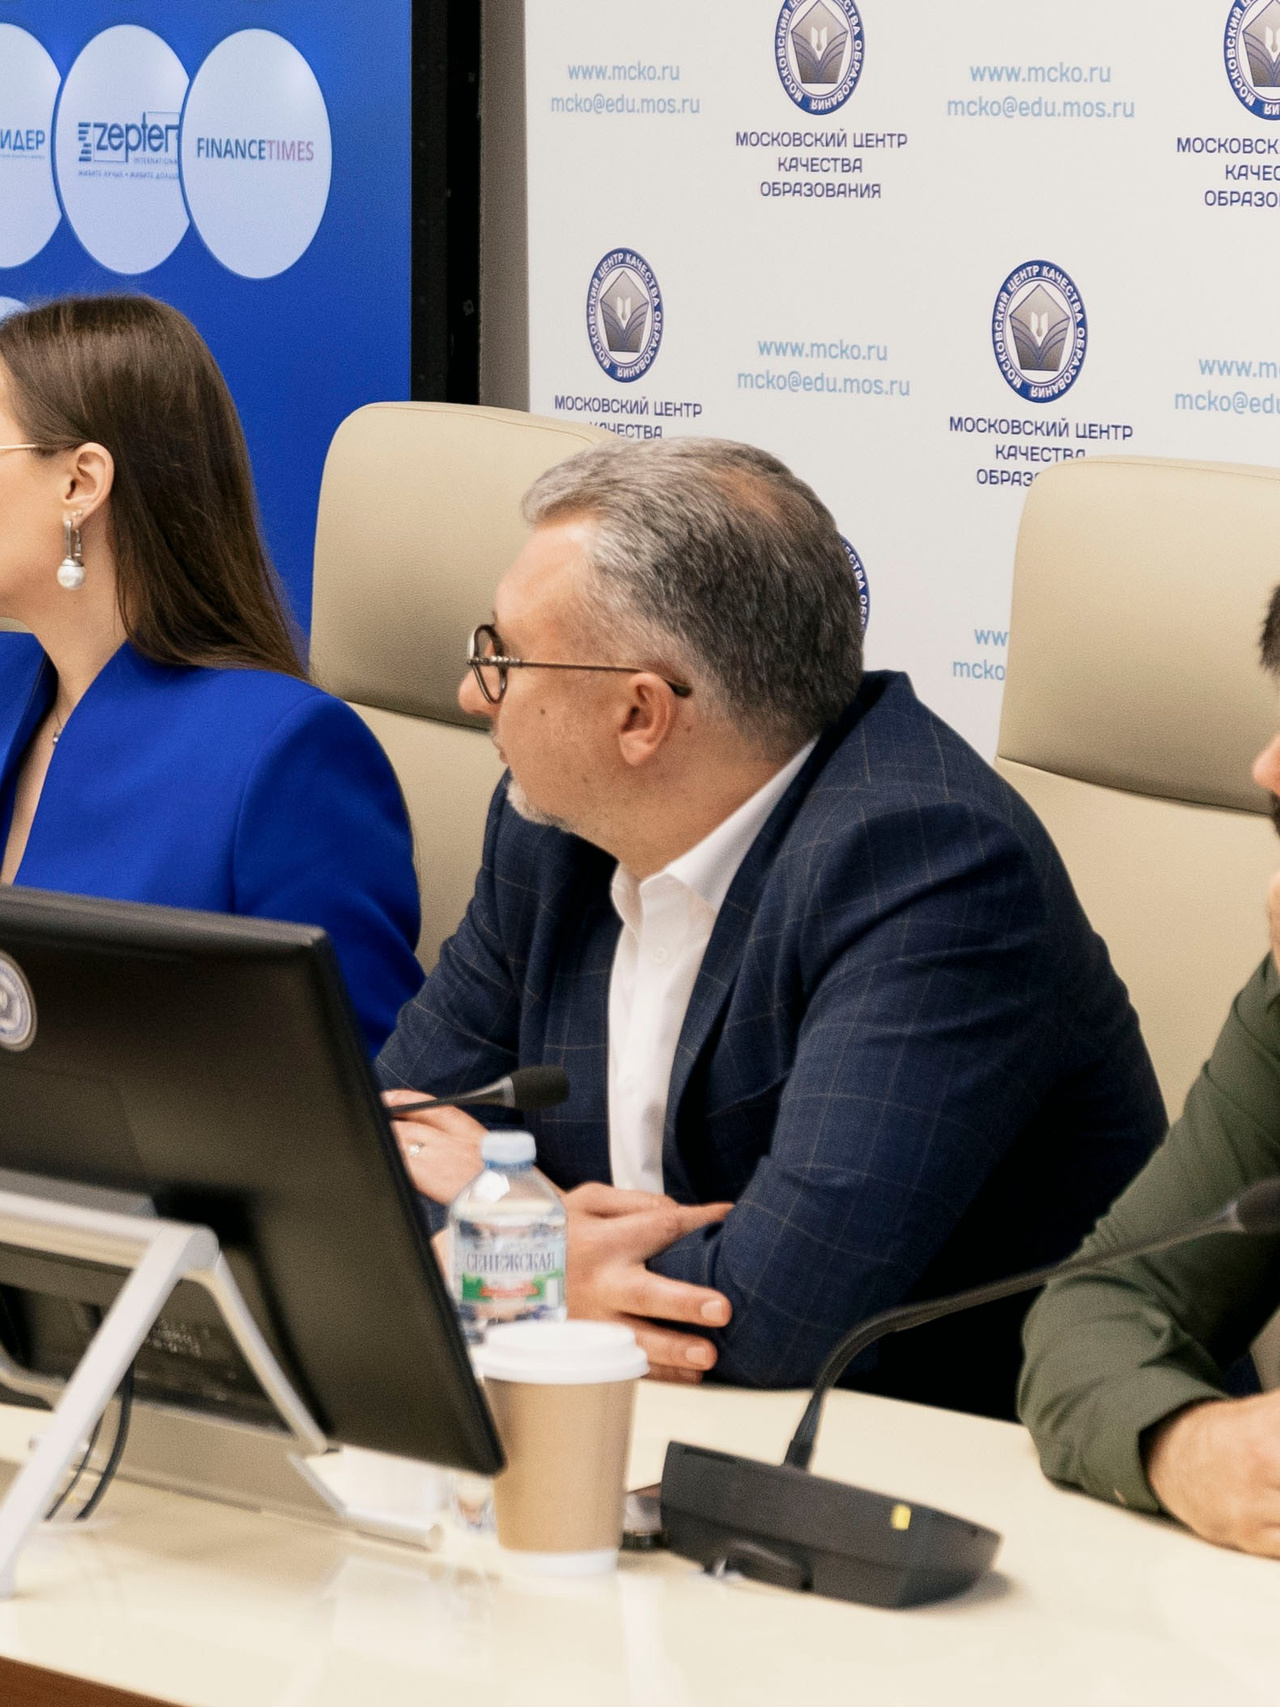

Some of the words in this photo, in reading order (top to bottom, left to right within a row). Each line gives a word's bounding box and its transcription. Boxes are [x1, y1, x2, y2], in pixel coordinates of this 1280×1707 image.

[567, 61, 680, 82] www.mcko.ru
[970, 62, 1112, 84] www.mcko.ru
[550, 94, 700, 115] mcko@edu.mos.ru
[947, 96, 1135, 119] mcko@edu.mos.ru
[735, 128, 847, 149] МОСКОВСКИЙ
[853, 132, 908, 149] ЦЕНТР
[1176, 137, 1280, 154] МОСКОВСК
[778, 157, 863, 174] КАЧЕСТВА
[1225, 164, 1280, 181] КАЧЕС
[760, 182, 882, 199] ОБРАЗОВАНИЯ
[1204, 189, 1280, 208] ОБРАЗО
[1007, 265, 1040, 291] ЦЕНТР
[1042, 266, 1084, 323] КАЧЕСТВА
[757, 339, 888, 361] www.mcko.ru
[1031, 327, 1086, 398] ОБРАЗОВАНИЯ
[1199, 358, 1280, 379] www.m
[737, 369, 910, 397] mcko@edu.mos.ru
[554, 395, 649, 415] МОСКОВСКИЙ
[654, 401, 703, 418] ЦЕНТР
[589, 421, 663, 439] ЧЕСТВА
[949, 416, 1070, 438] МОСКОВСКИЙ
[1075, 423, 1133, 441] ЦЕНТР
[976, 469, 1040, 488] ОБРАЗ
[953, 659, 1006, 681] mcko
